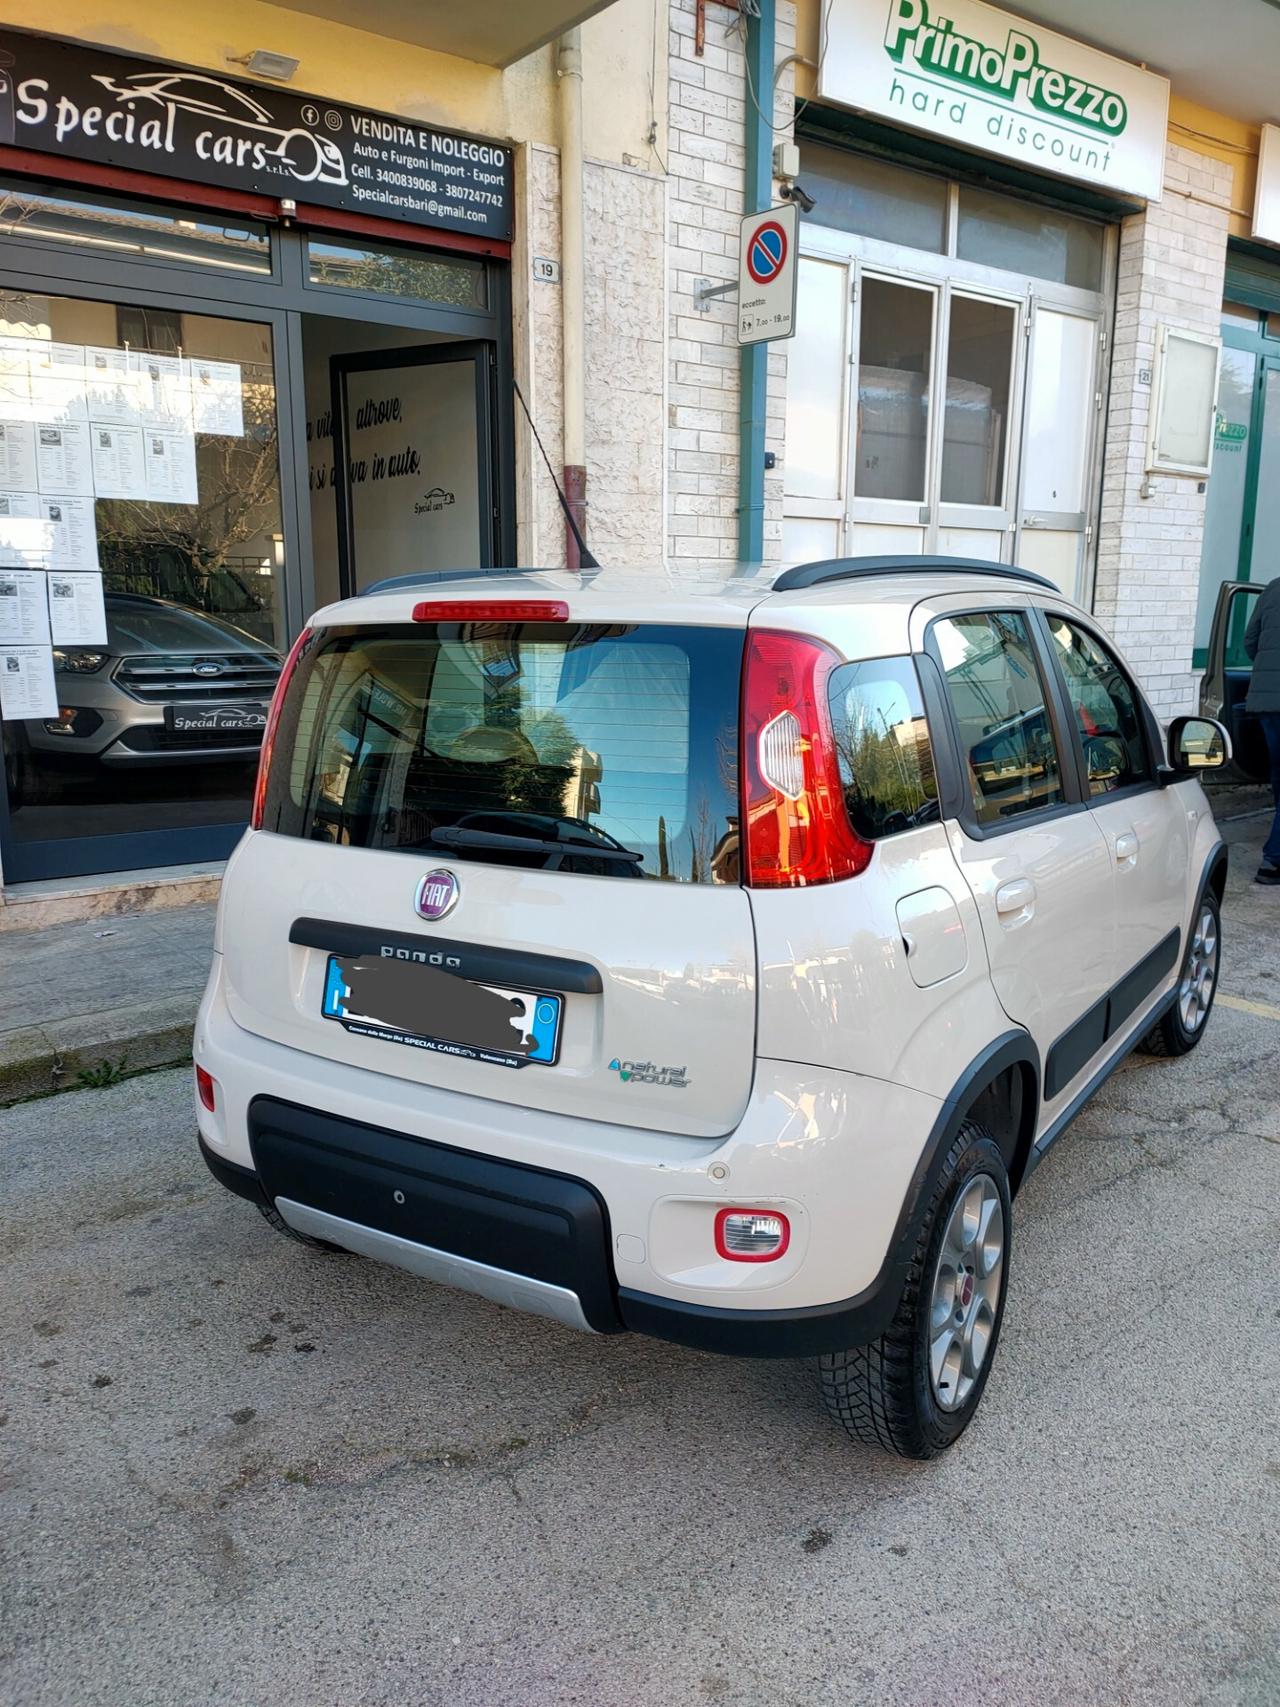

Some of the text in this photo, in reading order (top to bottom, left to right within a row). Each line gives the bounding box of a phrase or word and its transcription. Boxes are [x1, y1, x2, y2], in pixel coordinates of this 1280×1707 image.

[884, 0, 1127, 136] PrimoPrezzo
[17, 79, 175, 152] Special
[195, 130, 267, 170] cars
[889, 78, 1110, 171] hard discount
[350, 114, 505, 168] VENDITA E NOLEGGIO
[353, 142, 380, 160] Auto
[381, 150, 389, 161] e
[390, 150, 429, 170] Furgoni
[431, 159, 465, 178] Import
[473, 168, 505, 187] Export
[351, 163, 375, 180] Cell.
[376, 168, 438, 194] 3400839068
[445, 183, 503, 208] 3807247742
[352, 184, 488, 224] Specialcarsbari@gmail.com
[541, 264, 553, 277] 19
[372, 452, 387, 481] in
[174, 712, 217, 731] Special
[220, 718, 243, 728] cars
[421, 882, 450, 907] FIAT
[380, 945, 461, 969] panda
[404, 1036, 437, 1049] SPECIAL
[437, 1043, 461, 1055] CARS
[621, 1059, 687, 1078] natural
[629, 1071, 692, 1089] power
